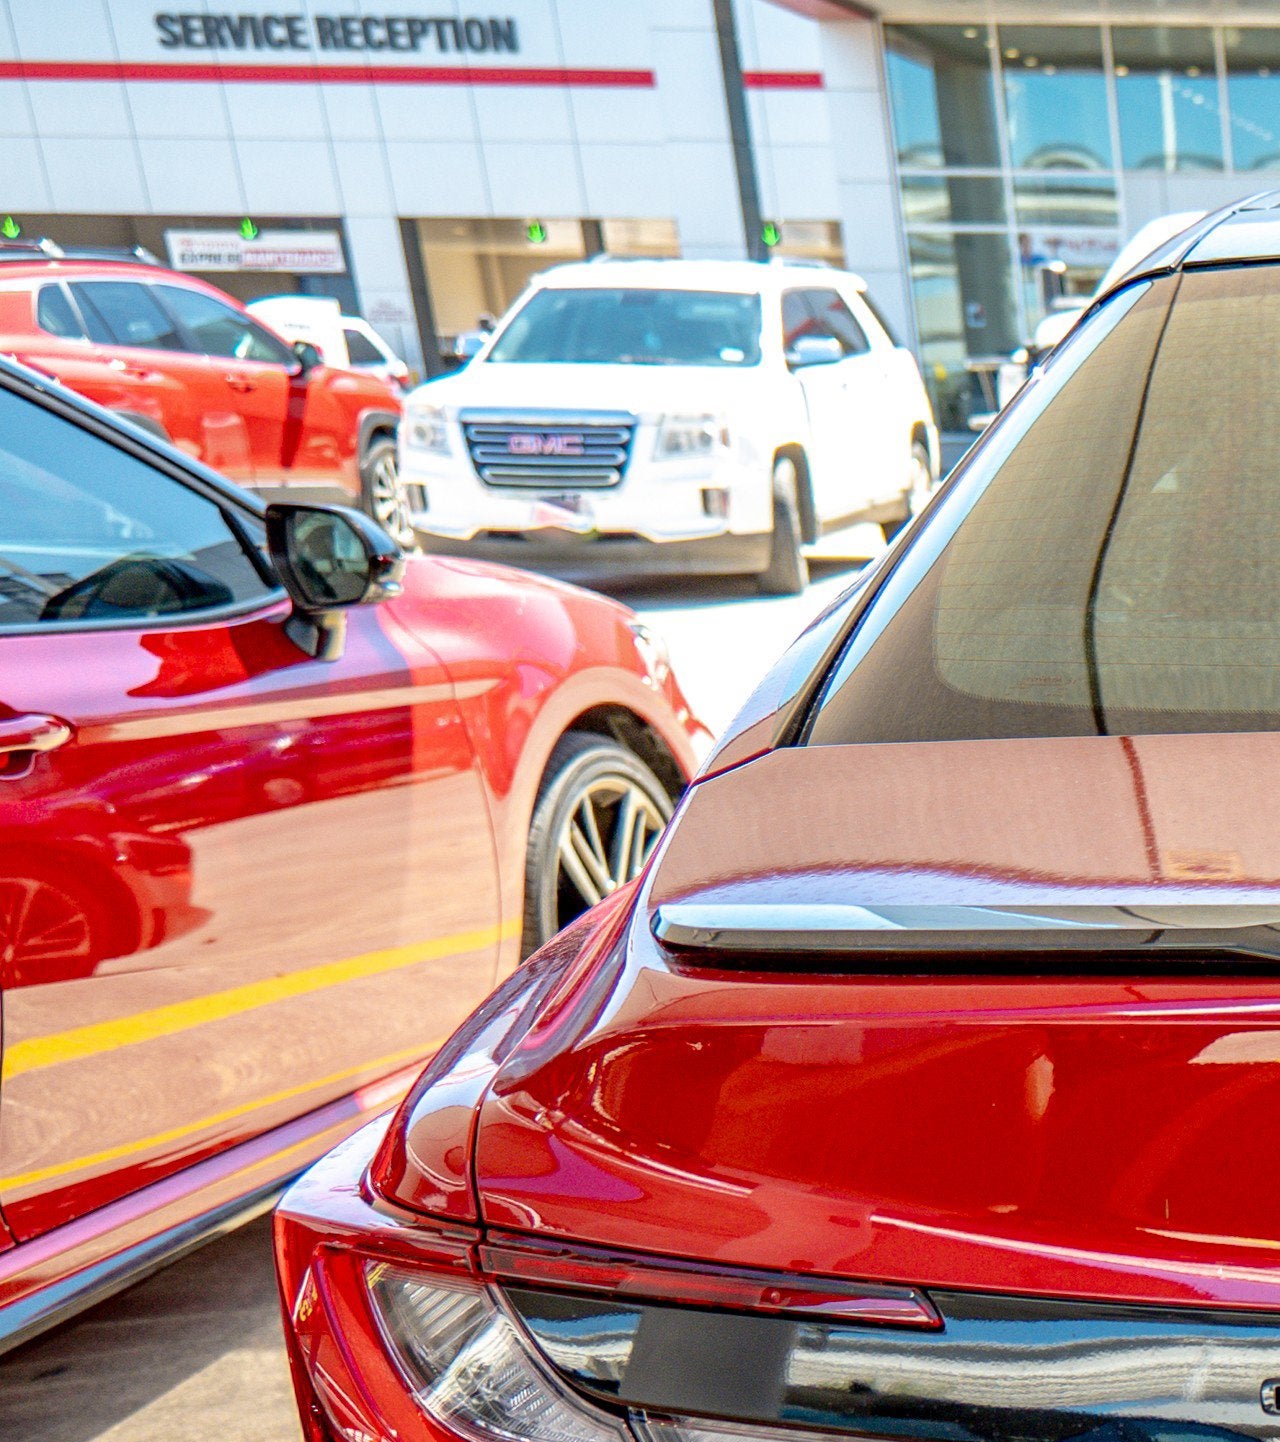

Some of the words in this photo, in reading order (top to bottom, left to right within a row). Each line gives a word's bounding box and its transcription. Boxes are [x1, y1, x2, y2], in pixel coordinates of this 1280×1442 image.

[155, 14, 311, 50] SERVICE
[315, 15, 520, 54] RECEPTION
[508, 433, 584, 456] GMC
